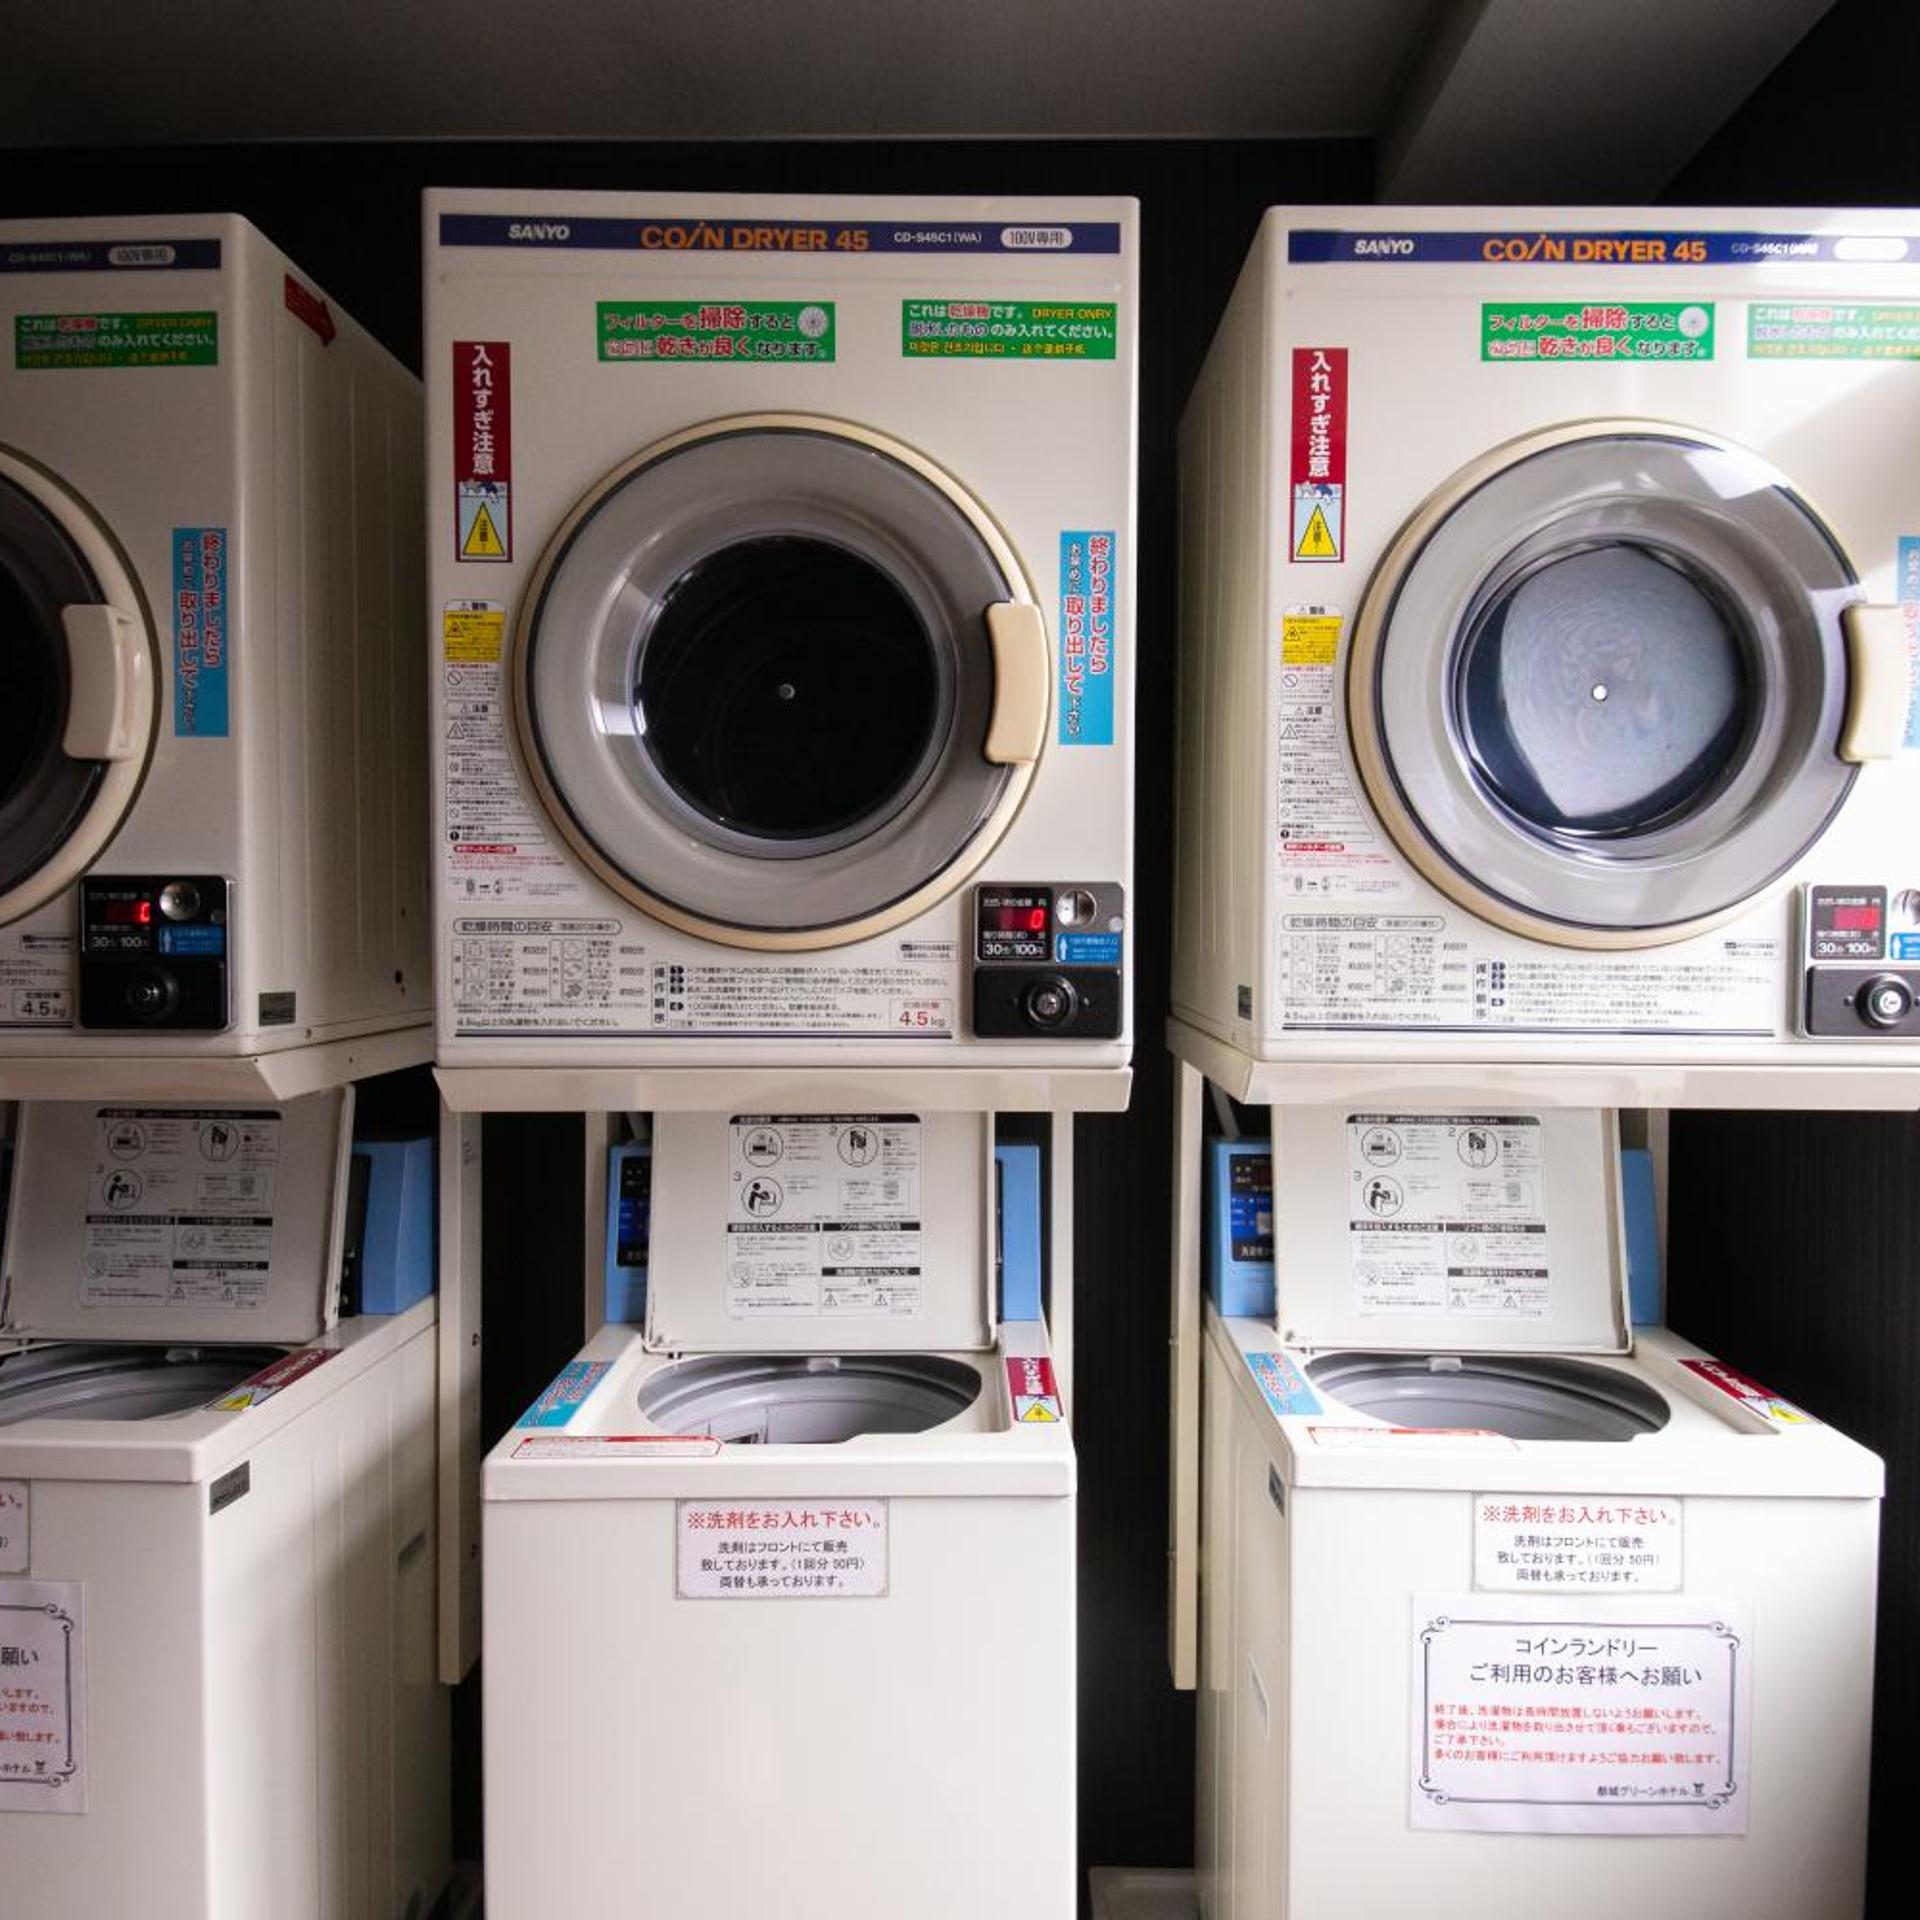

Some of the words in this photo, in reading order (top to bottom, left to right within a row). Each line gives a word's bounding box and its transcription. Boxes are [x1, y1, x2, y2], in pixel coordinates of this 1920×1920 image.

[508, 223, 571, 241] SANYO
[733, 228, 833, 252] DRYER
[835, 229, 871, 252] 45
[1354, 238, 1415, 255] SANYO
[1573, 240, 1665, 261] DRYER
[1674, 240, 1707, 261] 45
[1488, 307, 1675, 331] フィルターを掃除すると
[471, 344, 496, 476] 入れすぎ注意
[1308, 350, 1332, 478] 入れすぎ注意
[1090, 536, 1109, 674] 終わりましたら
[1030, 908, 1046, 930] 0
[718, 1541, 848, 1555] 洗剤はフロントにて販売
[1514, 1535, 1645, 1549] 洗剤はフロントにて販売
[719, 1575, 844, 1589] 両替も承っております。
[1516, 1568, 1640, 1584] 両替も承っております。
[1516, 1637, 1659, 1657] コインランドリー
[1470, 1662, 1703, 1686] ご利用のお客様へお願い
[1434, 1734, 1505, 1747] ご了承下さい。
[1597, 1786, 1690, 1797] 都城グリーンホテル
